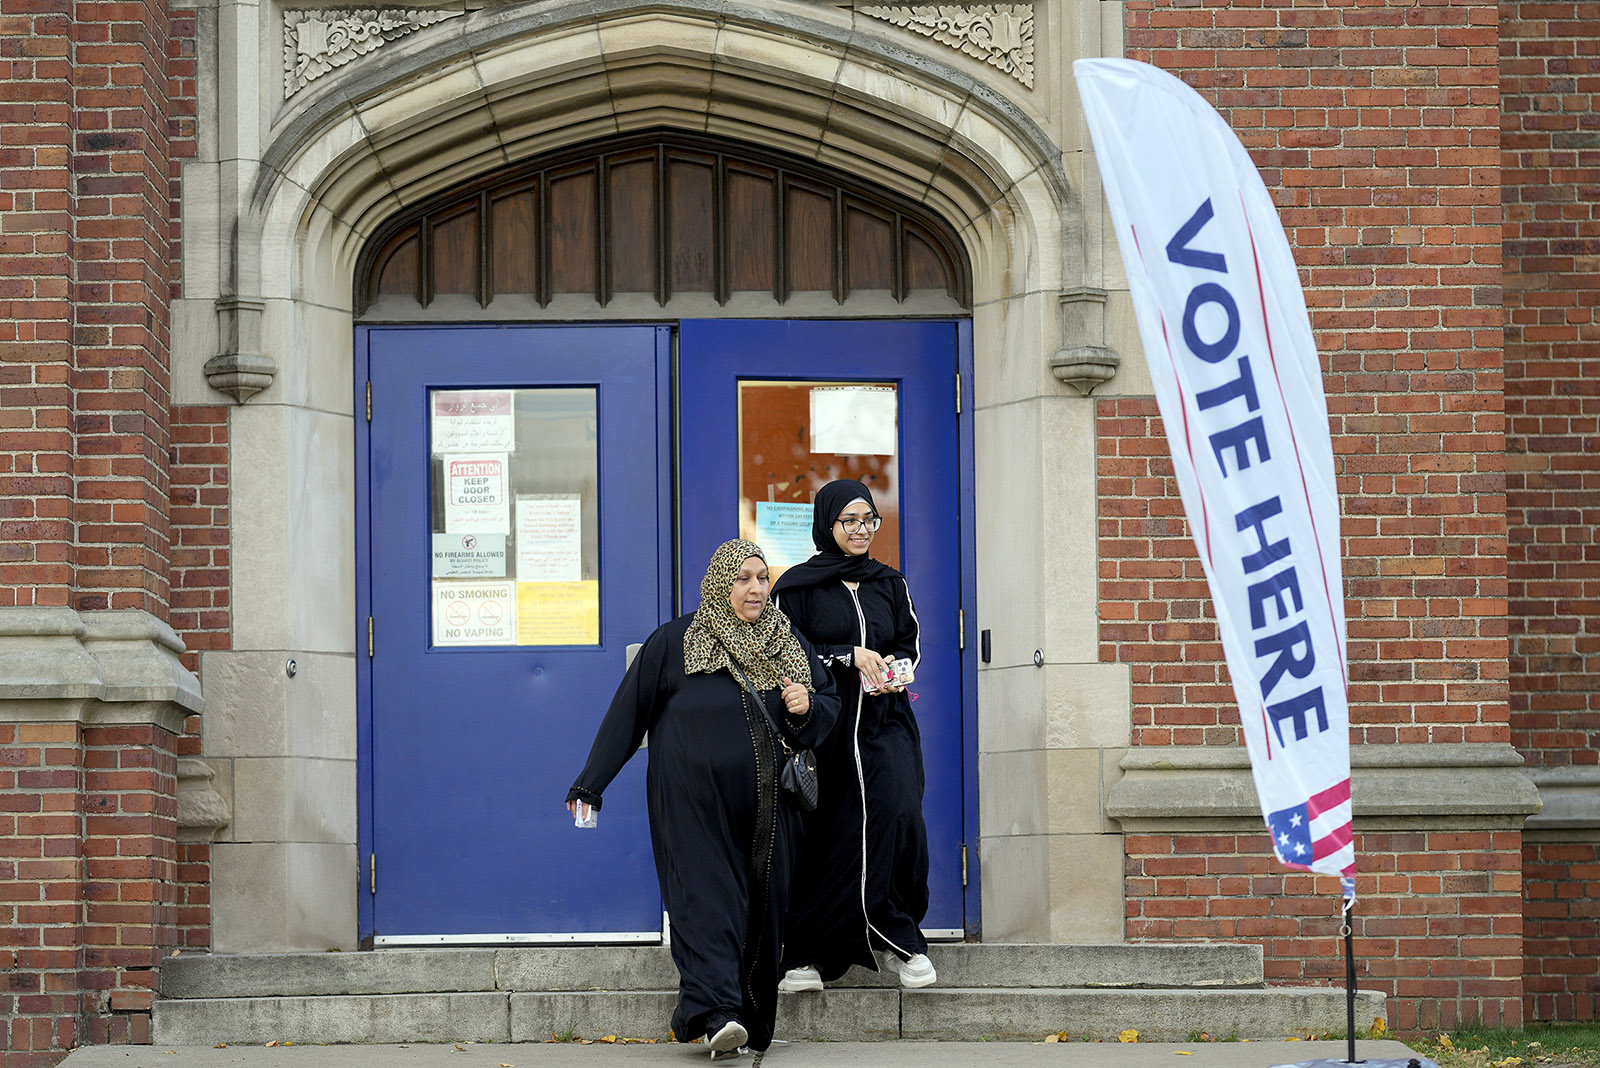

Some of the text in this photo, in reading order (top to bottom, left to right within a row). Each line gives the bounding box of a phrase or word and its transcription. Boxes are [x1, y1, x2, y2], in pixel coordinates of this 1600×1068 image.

[452, 463, 501, 475] ATTENTION
[1166, 197, 1329, 748] VOTE HERE
[463, 486, 490, 494] DOOR
[458, 495, 496, 503] CLOSED
[440, 589, 508, 599] NO SMOKING
[446, 628, 504, 638] NO VAPING
